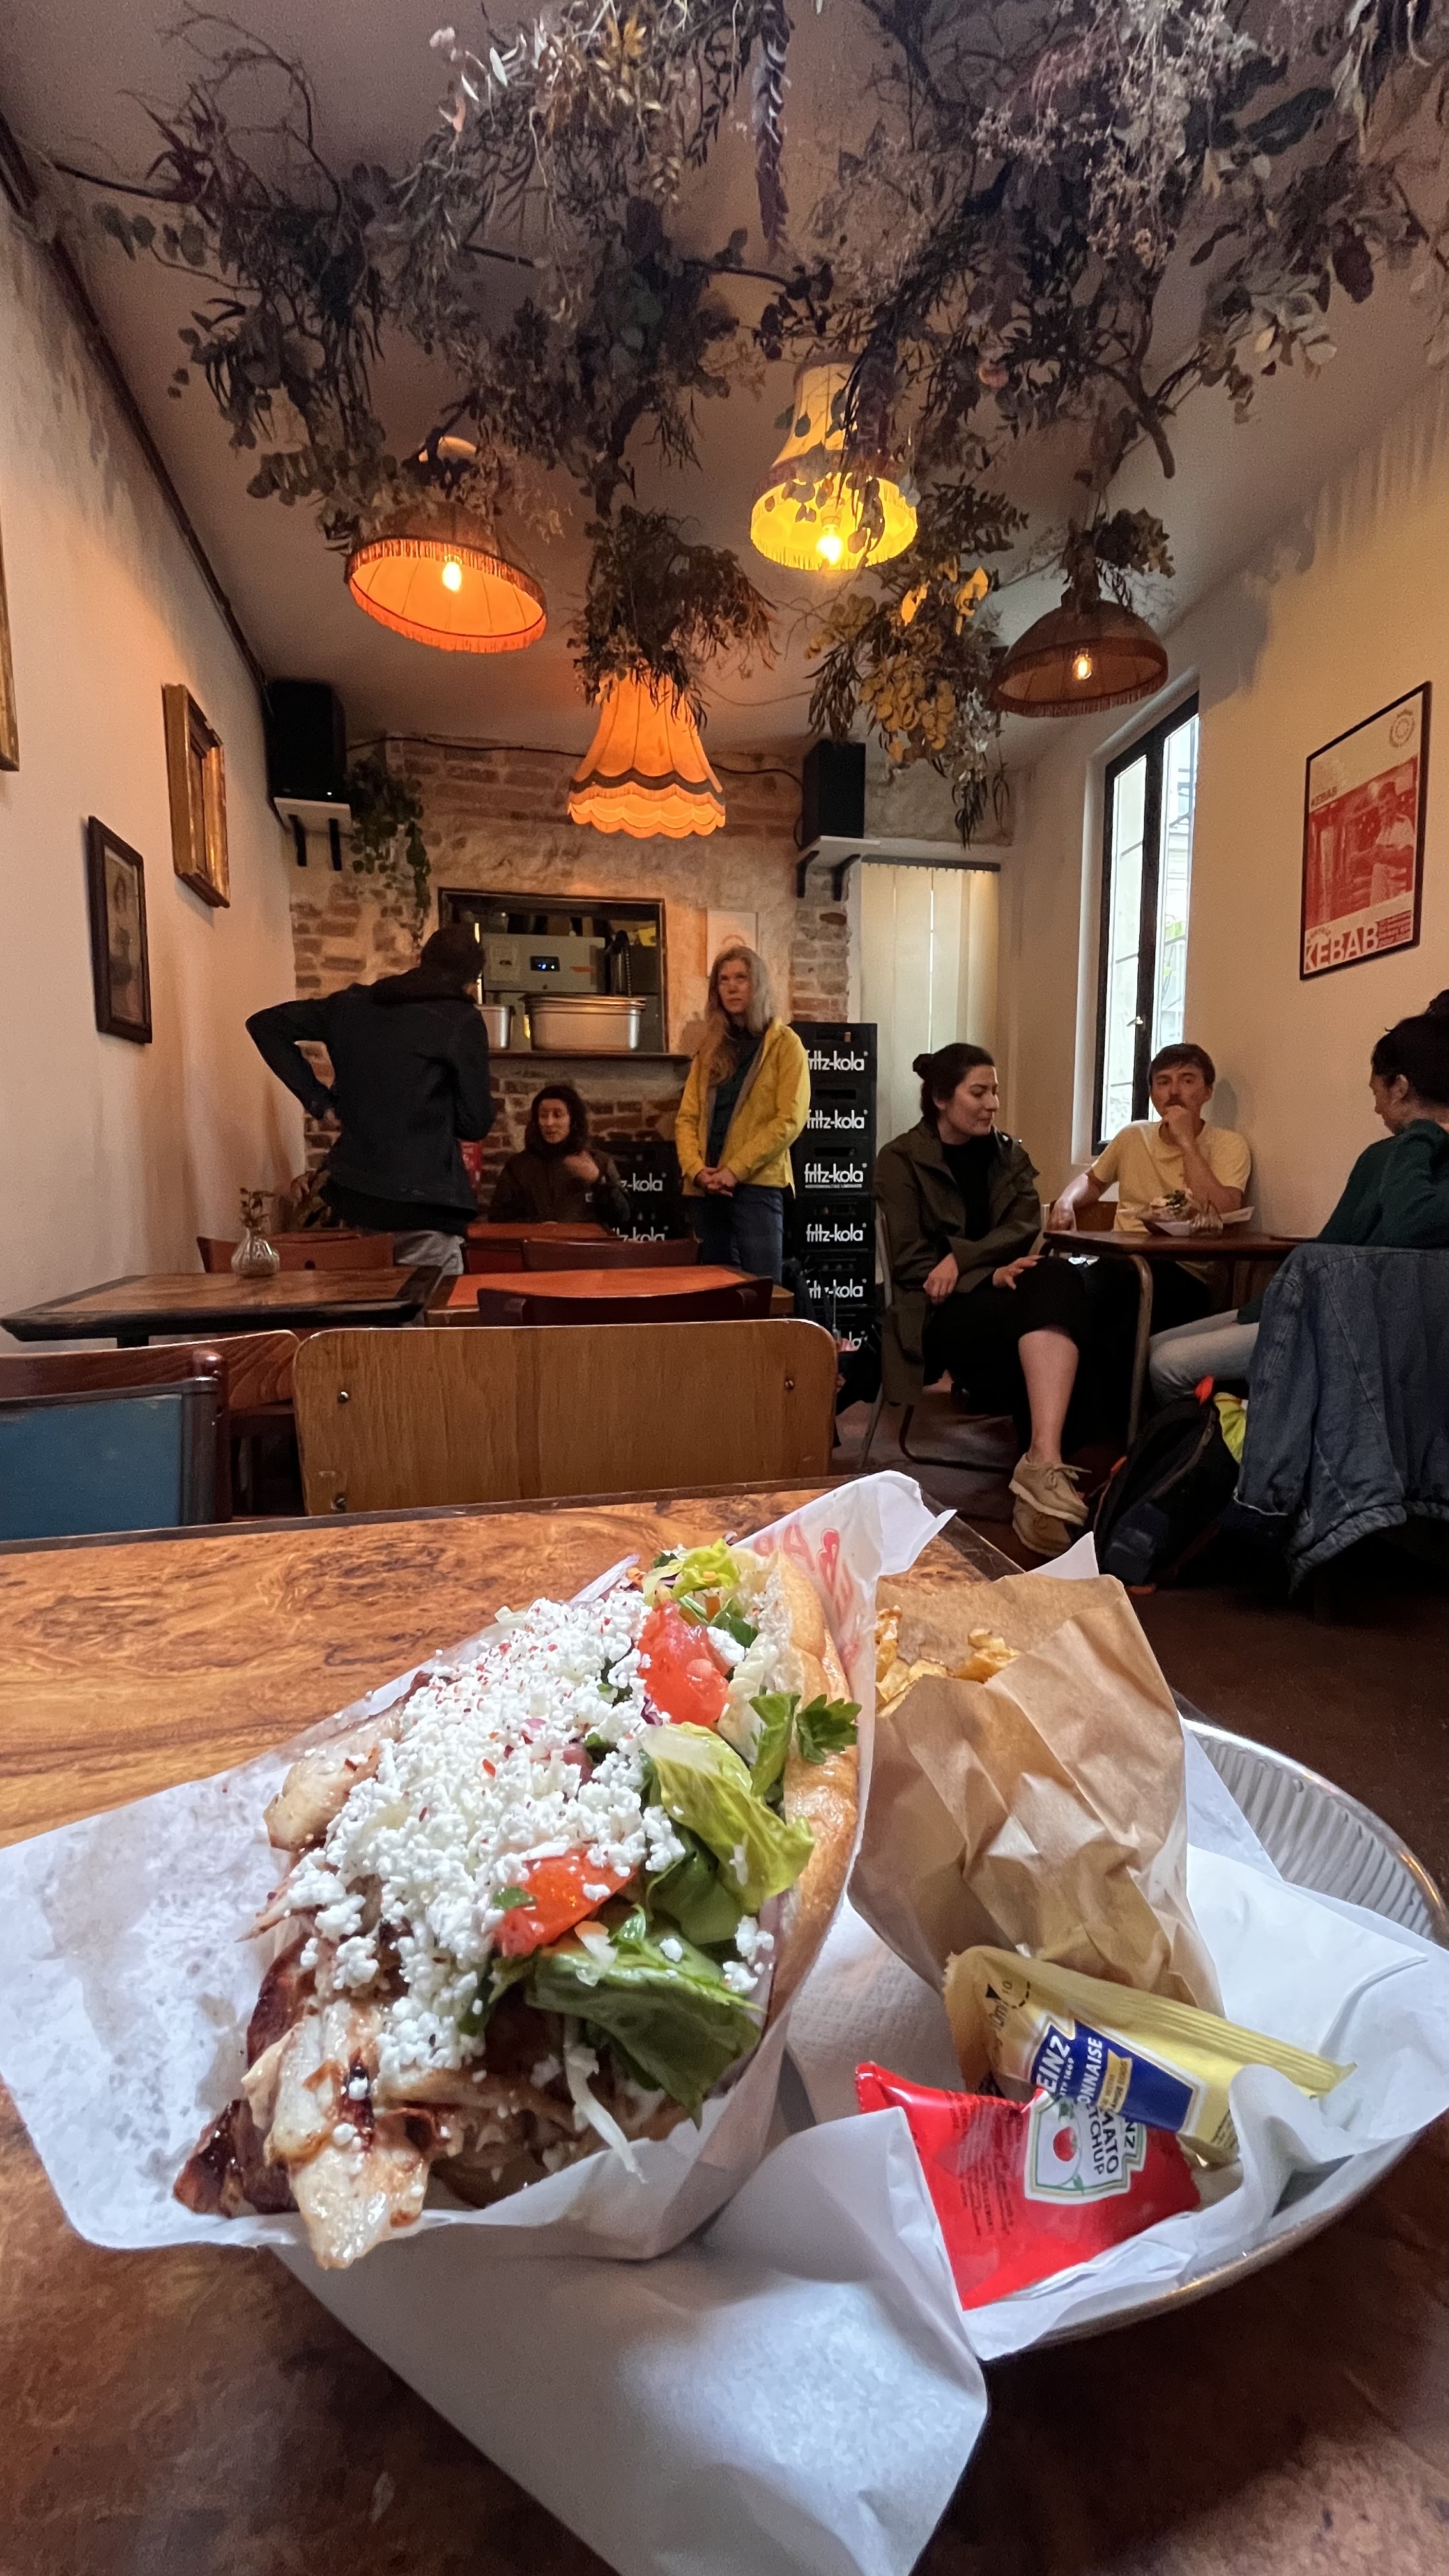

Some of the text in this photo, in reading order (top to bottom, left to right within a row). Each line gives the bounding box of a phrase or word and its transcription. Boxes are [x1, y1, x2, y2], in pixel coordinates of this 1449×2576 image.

[1304, 923, 1379, 972] KEBAB
[804, 1163, 864, 1183] fritz-kola
[806, 1223, 863, 1242] fritz-kola
[1036, 2035, 1071, 2093] EINZ
[1077, 2037, 1103, 2104] ONNAISE
